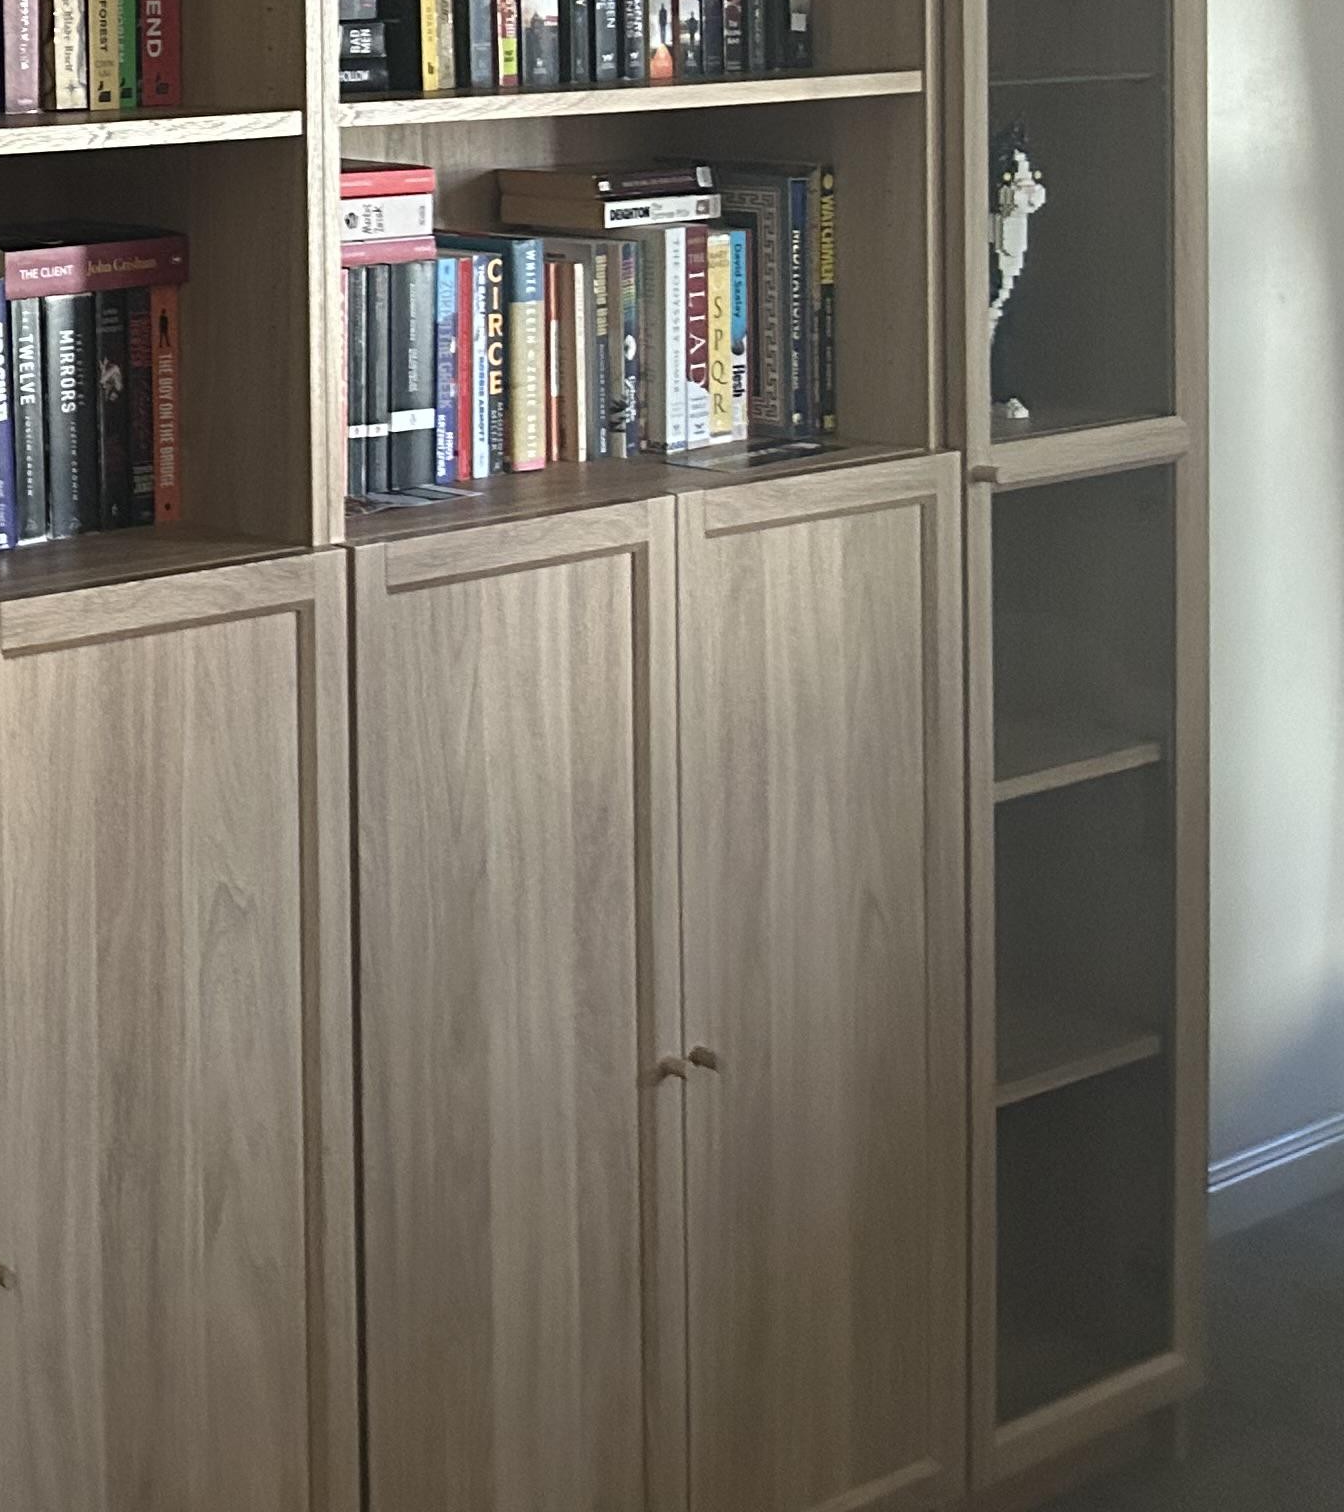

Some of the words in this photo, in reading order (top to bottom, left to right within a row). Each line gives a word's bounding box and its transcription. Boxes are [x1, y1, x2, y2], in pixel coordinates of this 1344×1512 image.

[146, 0, 160, 57] END
[350, 30, 360, 53] BAD
[361, 28, 370, 53] MEN
[820, 198, 833, 285] WATCHMEN
[487, 259, 502, 394] CIRCE
[19, 334, 34, 406] TWELVE
[60, 330, 75, 412] MIRRORS
